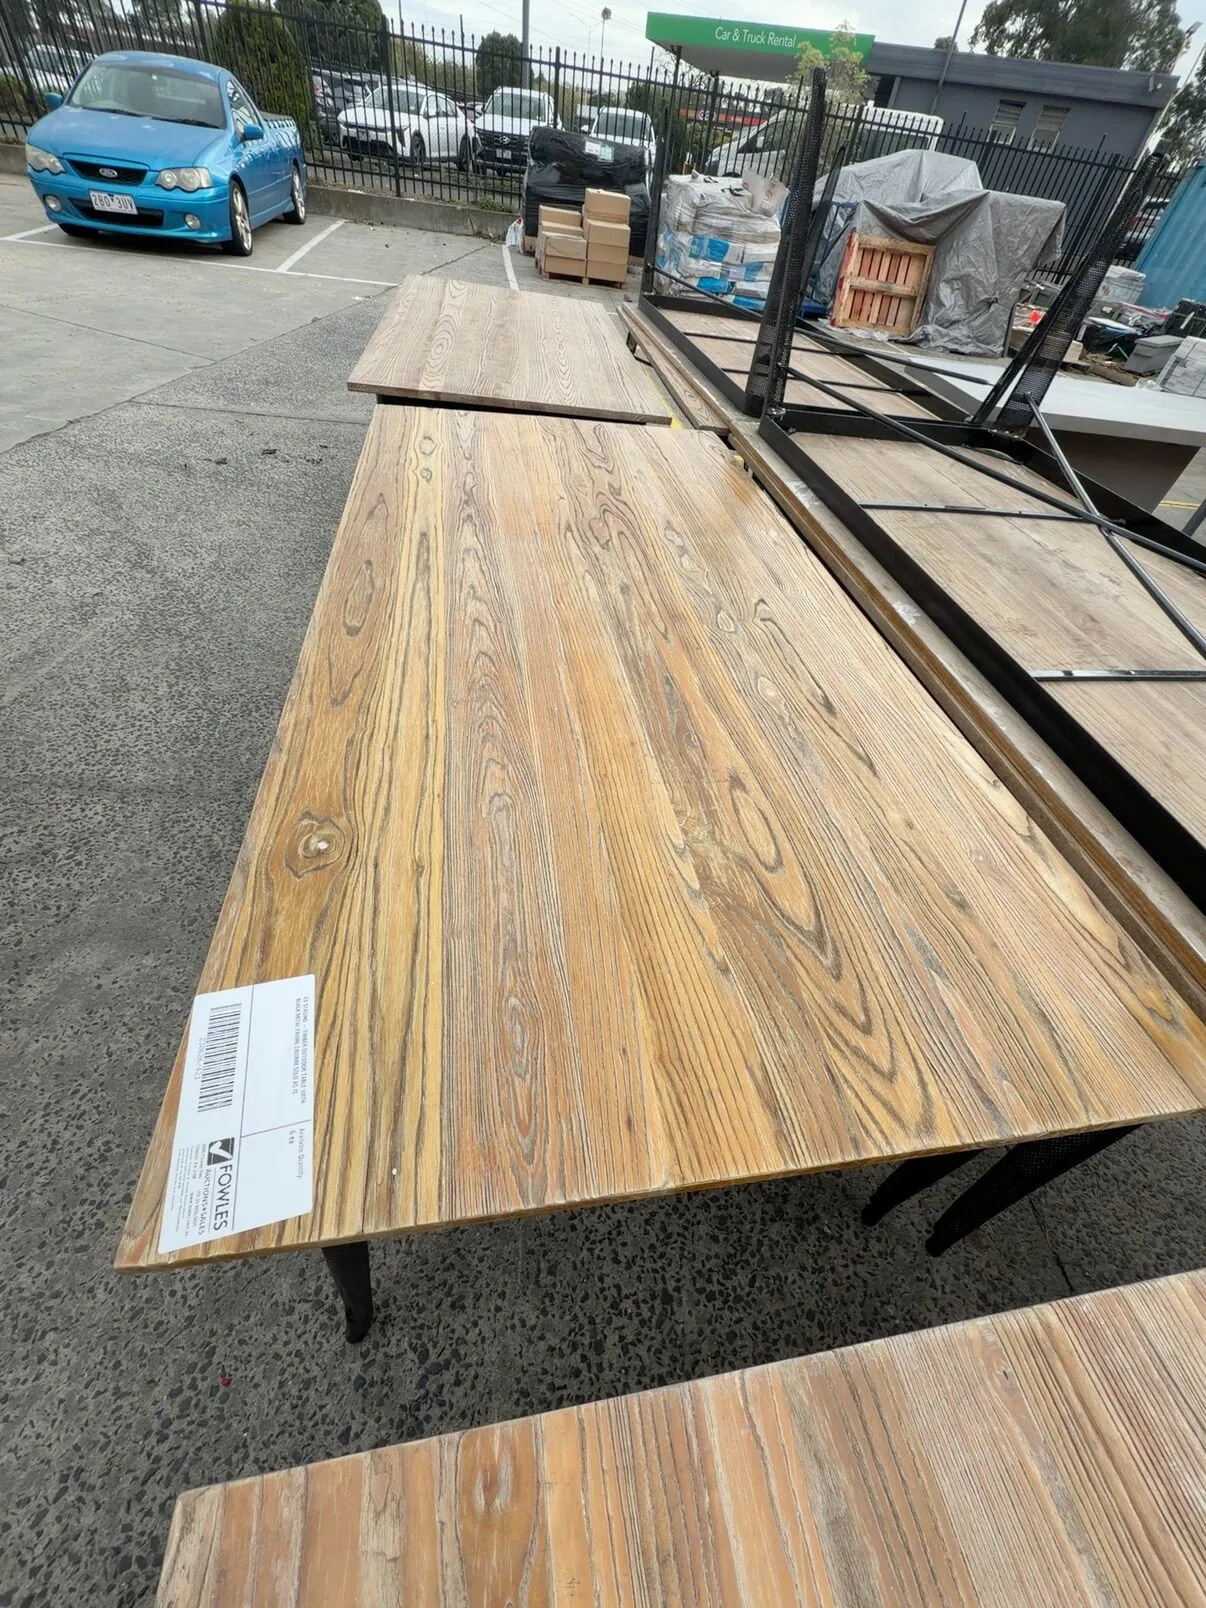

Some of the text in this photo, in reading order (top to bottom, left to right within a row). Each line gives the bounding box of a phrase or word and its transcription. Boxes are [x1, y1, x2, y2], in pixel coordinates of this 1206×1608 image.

[715, 26, 797, 48] Car & Truck Rental
[213, 1164, 232, 1231] FOWLES
